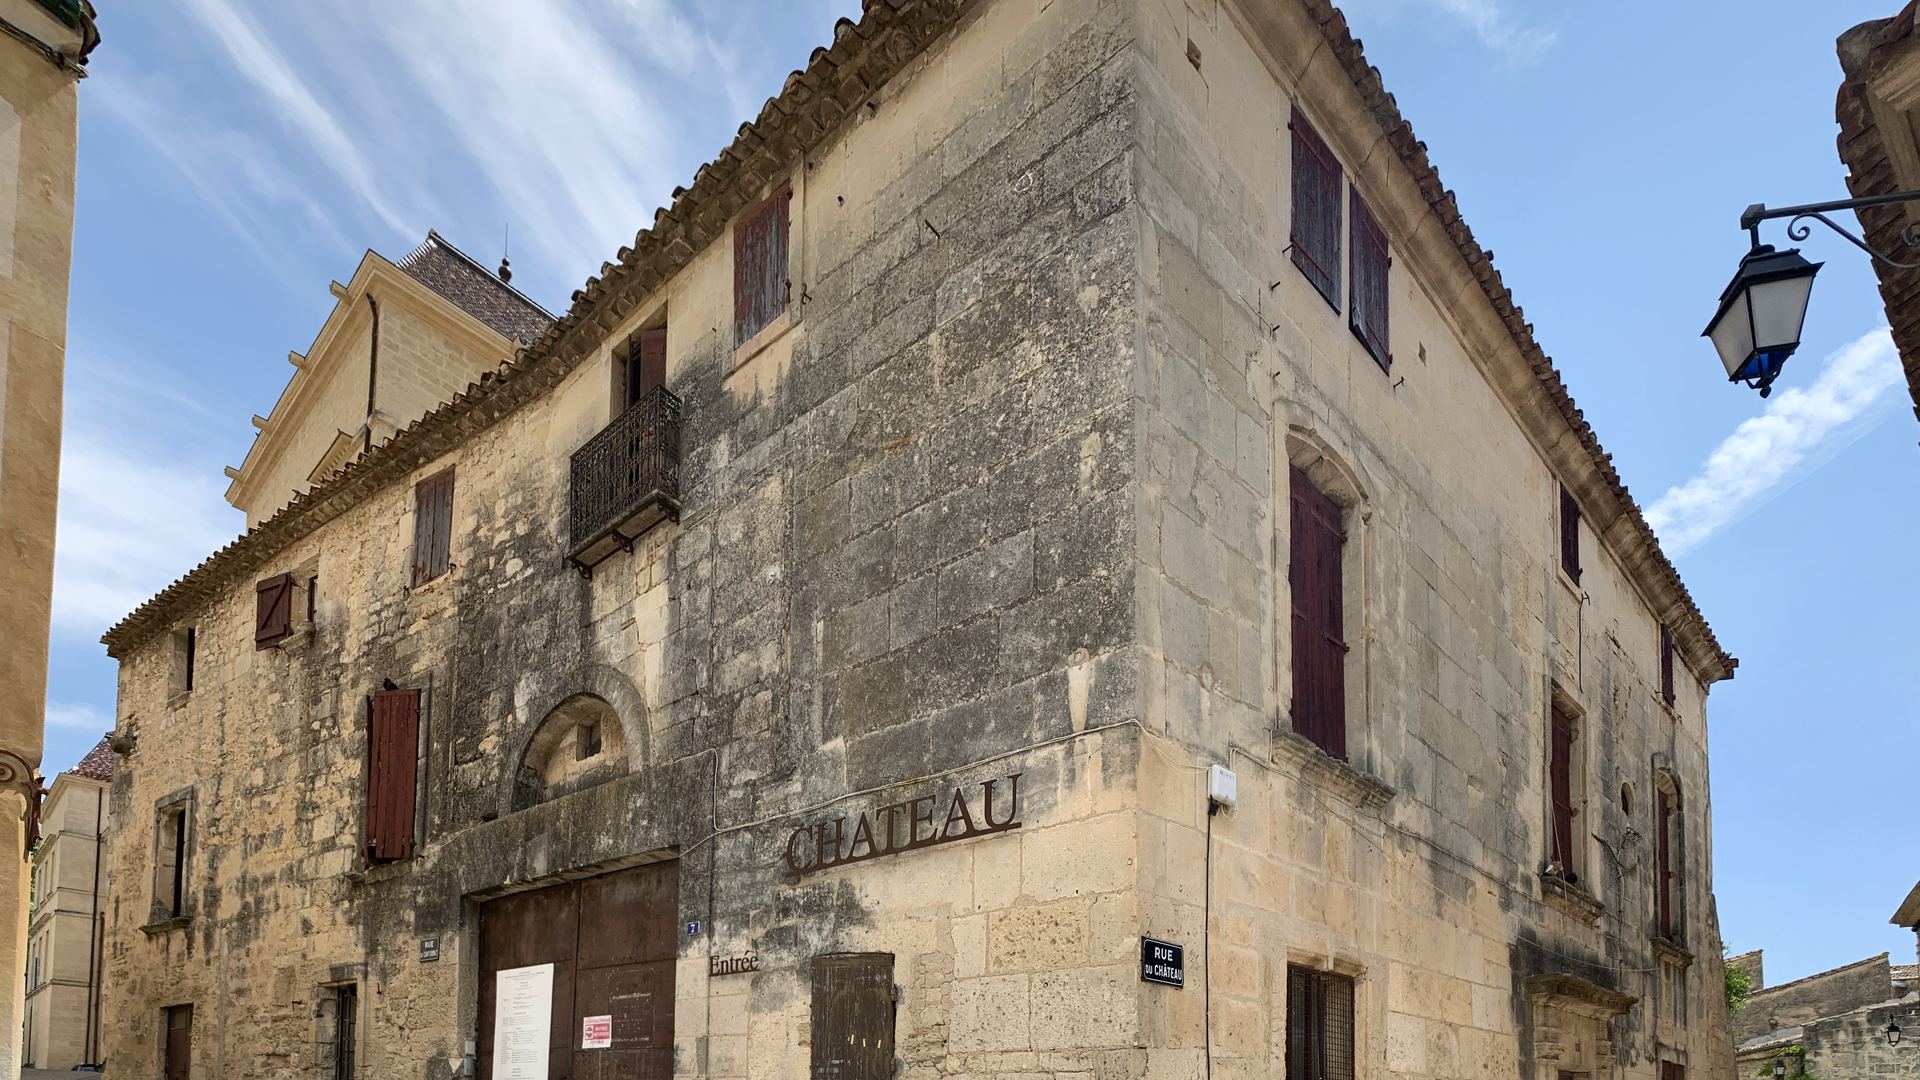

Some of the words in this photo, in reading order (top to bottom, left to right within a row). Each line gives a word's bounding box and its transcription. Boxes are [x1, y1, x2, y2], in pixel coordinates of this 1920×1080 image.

[786, 773, 1023, 877] CHATEAU
[690, 924, 696, 933] 7
[1154, 946, 1174, 962] RUE
[709, 950, 759, 977] Entrée
[1145, 964, 1153, 975] DU
[1154, 963, 1183, 980] CHÂTEAU
